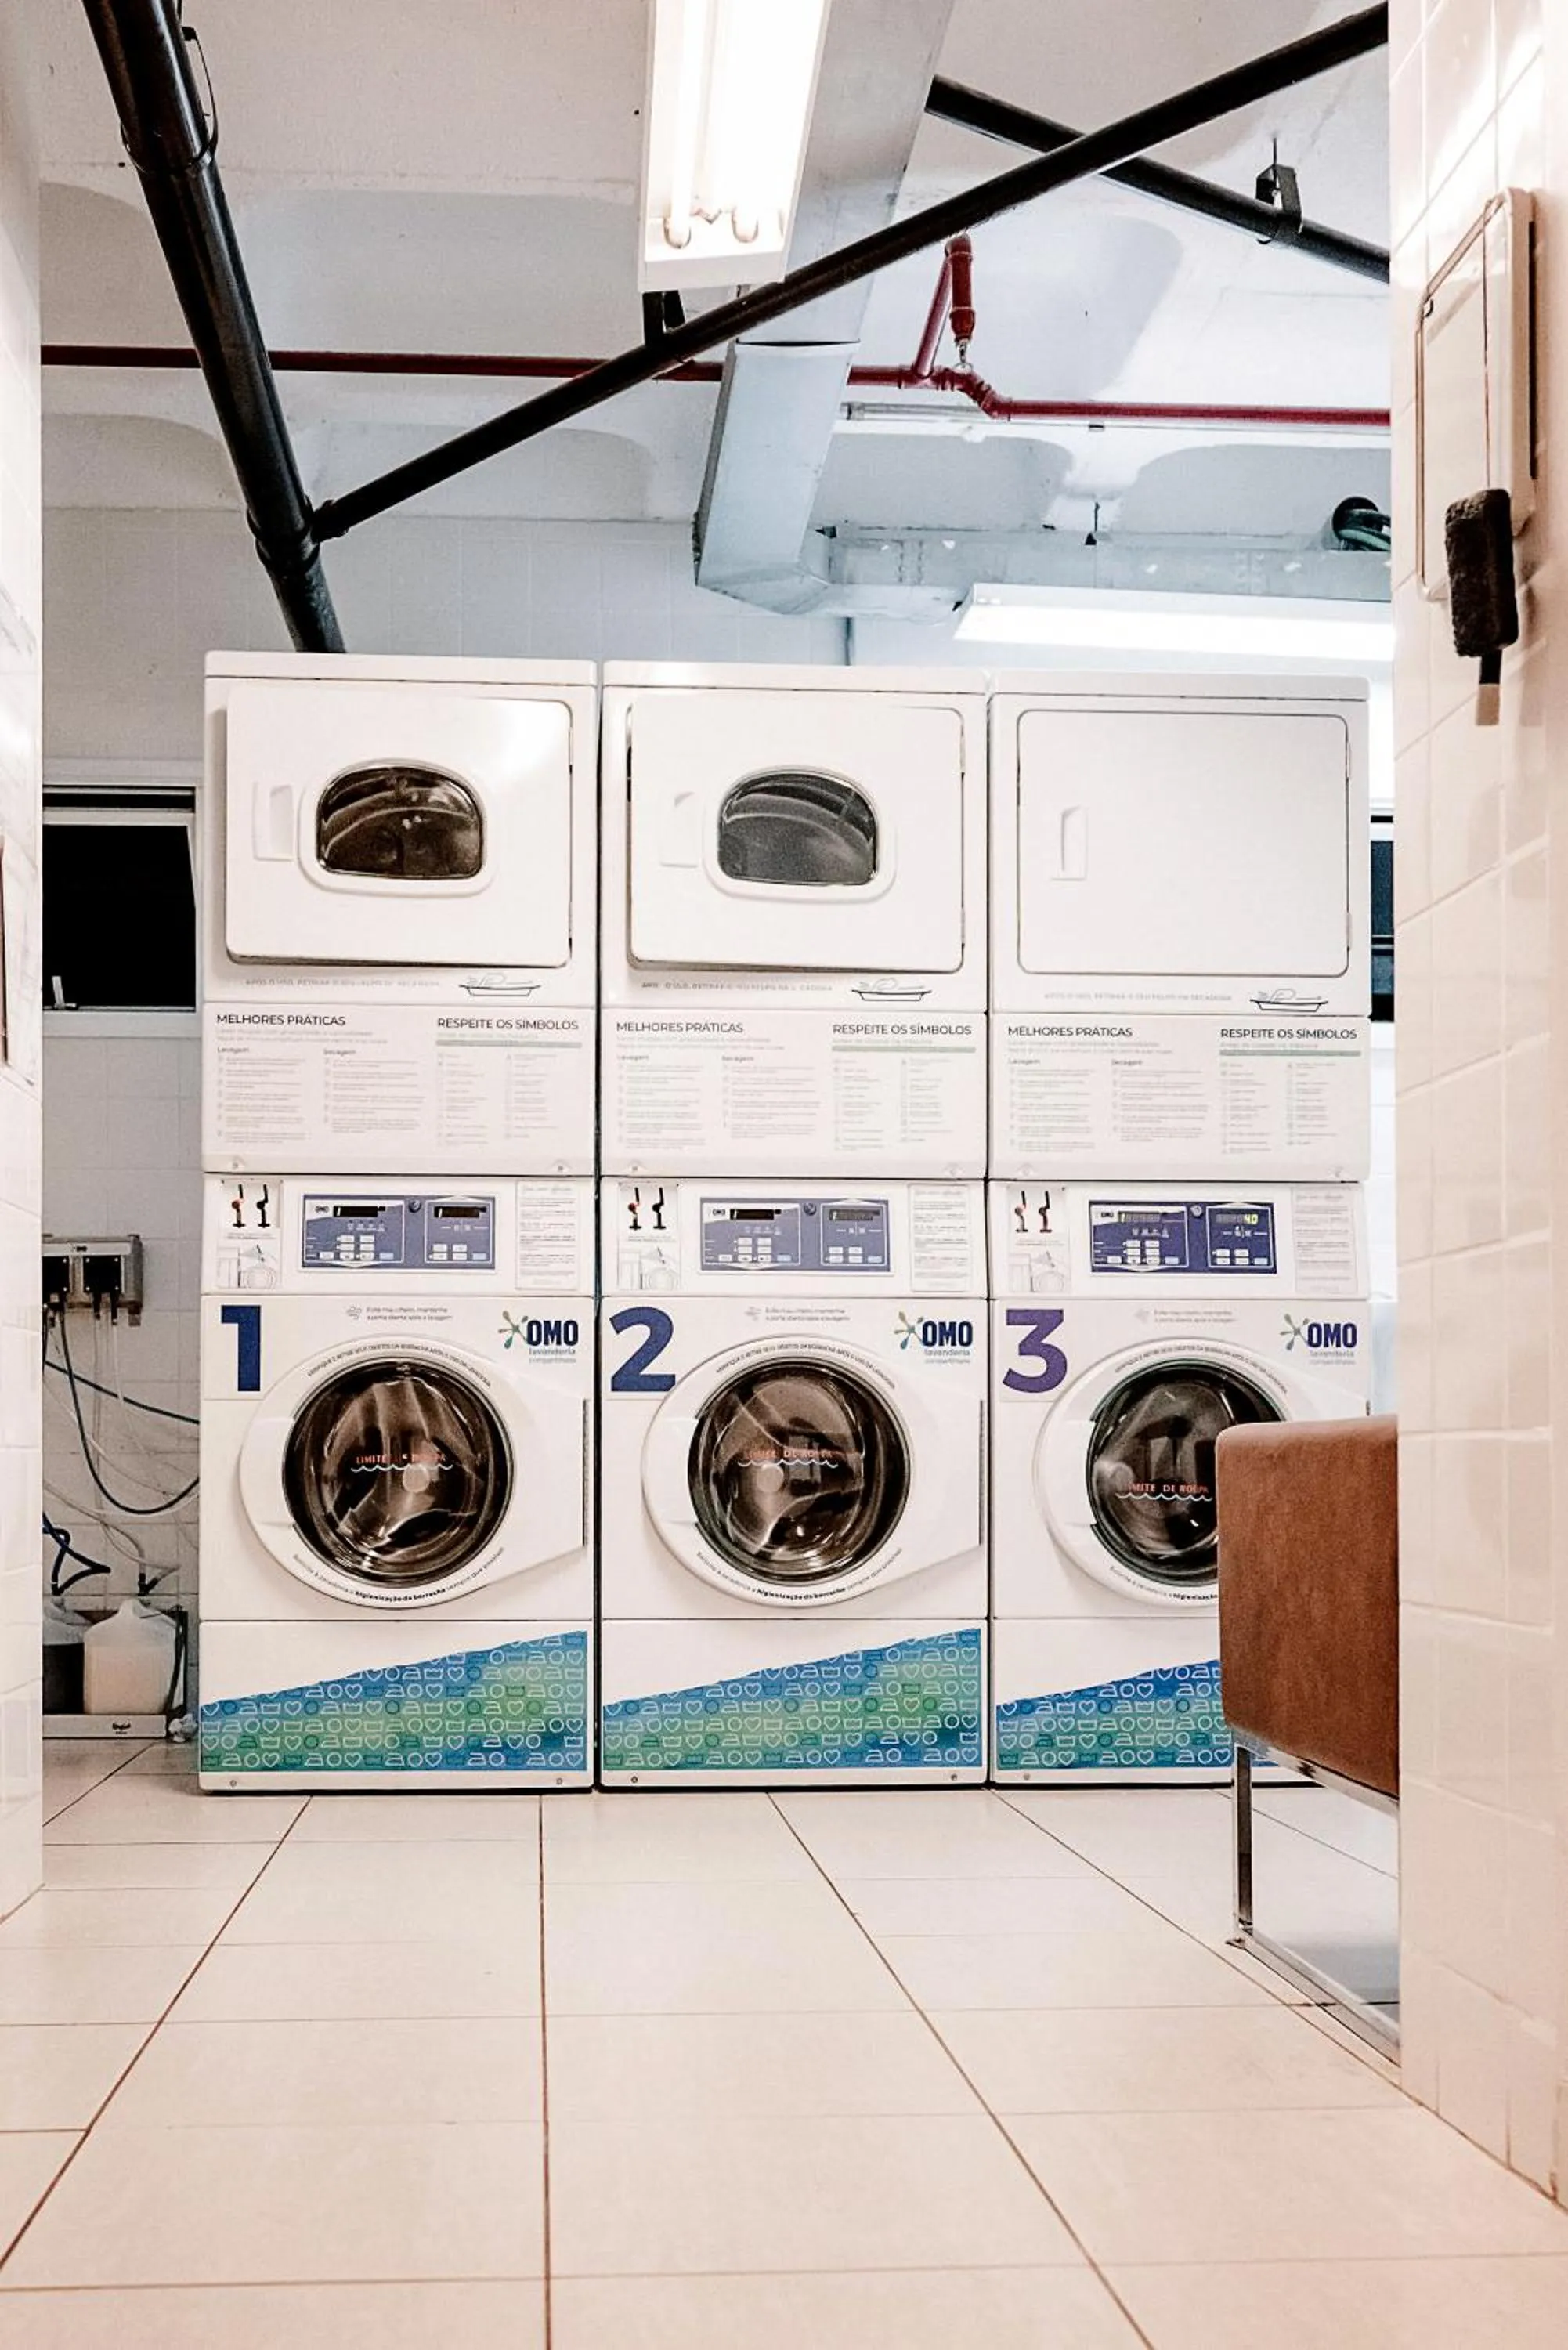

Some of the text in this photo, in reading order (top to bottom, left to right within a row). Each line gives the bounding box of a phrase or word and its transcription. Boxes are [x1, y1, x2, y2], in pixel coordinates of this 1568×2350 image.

[216, 1014, 346, 1026] MELHORES PRÁTICAS
[438, 1018, 579, 1030] RESPEITE OS SÍMBOLOS
[616, 1021, 744, 1033] MELHORES PRÁTICAS
[833, 1022, 972, 1036] RESPEITE OS SÍMBOLOS
[1008, 1025, 1133, 1037] MELHORES PRÁTICAS
[1221, 1027, 1357, 1039] RESPEITE OS SÍMBOLOS
[527, 1319, 579, 1347] OMO
[922, 1320, 974, 1347] OMO
[1307, 1322, 1357, 1348] OMO
[220, 1304, 262, 1392] 1
[609, 1306, 676, 1392] 2
[1002, 1309, 1068, 1394] 3
